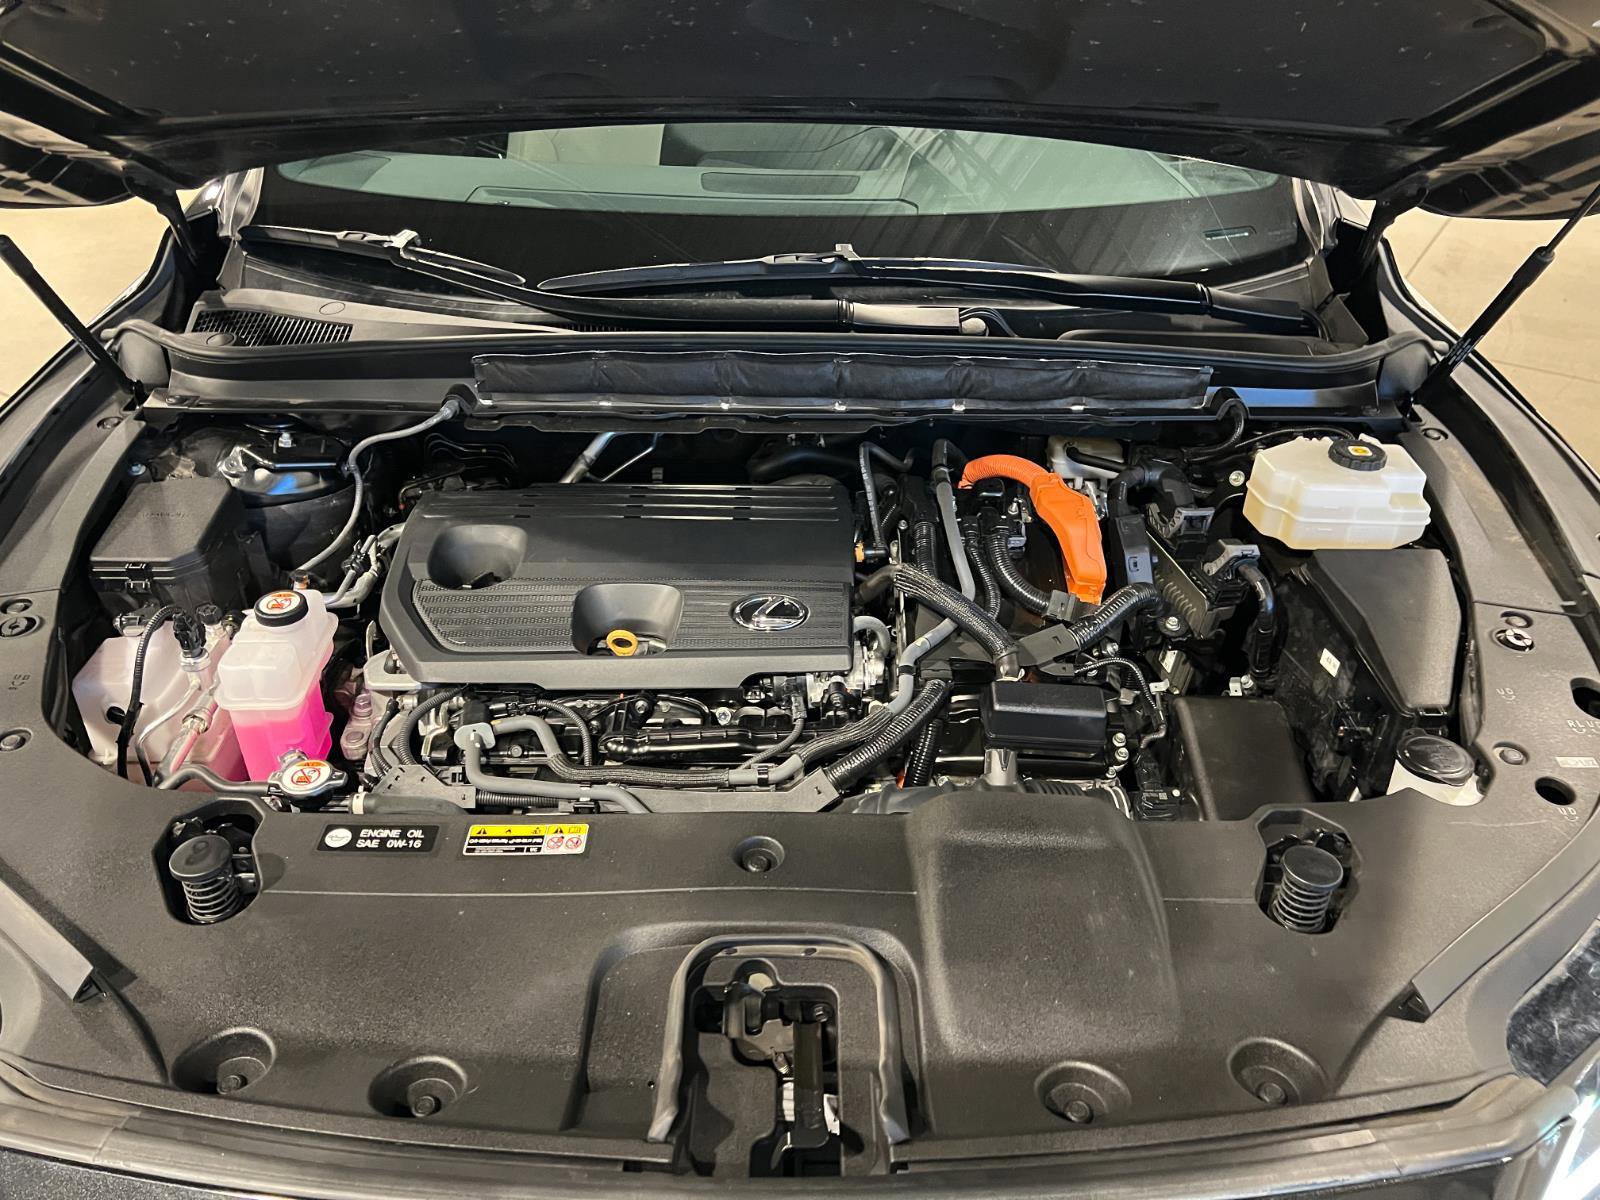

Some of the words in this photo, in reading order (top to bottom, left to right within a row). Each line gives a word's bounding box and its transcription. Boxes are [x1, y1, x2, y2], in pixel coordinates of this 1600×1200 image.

[359, 829, 402, 838] ENGINE
[406, 829, 425, 838] OIL
[355, 839, 380, 848] SAE
[386, 839, 422, 848] 0W-16
